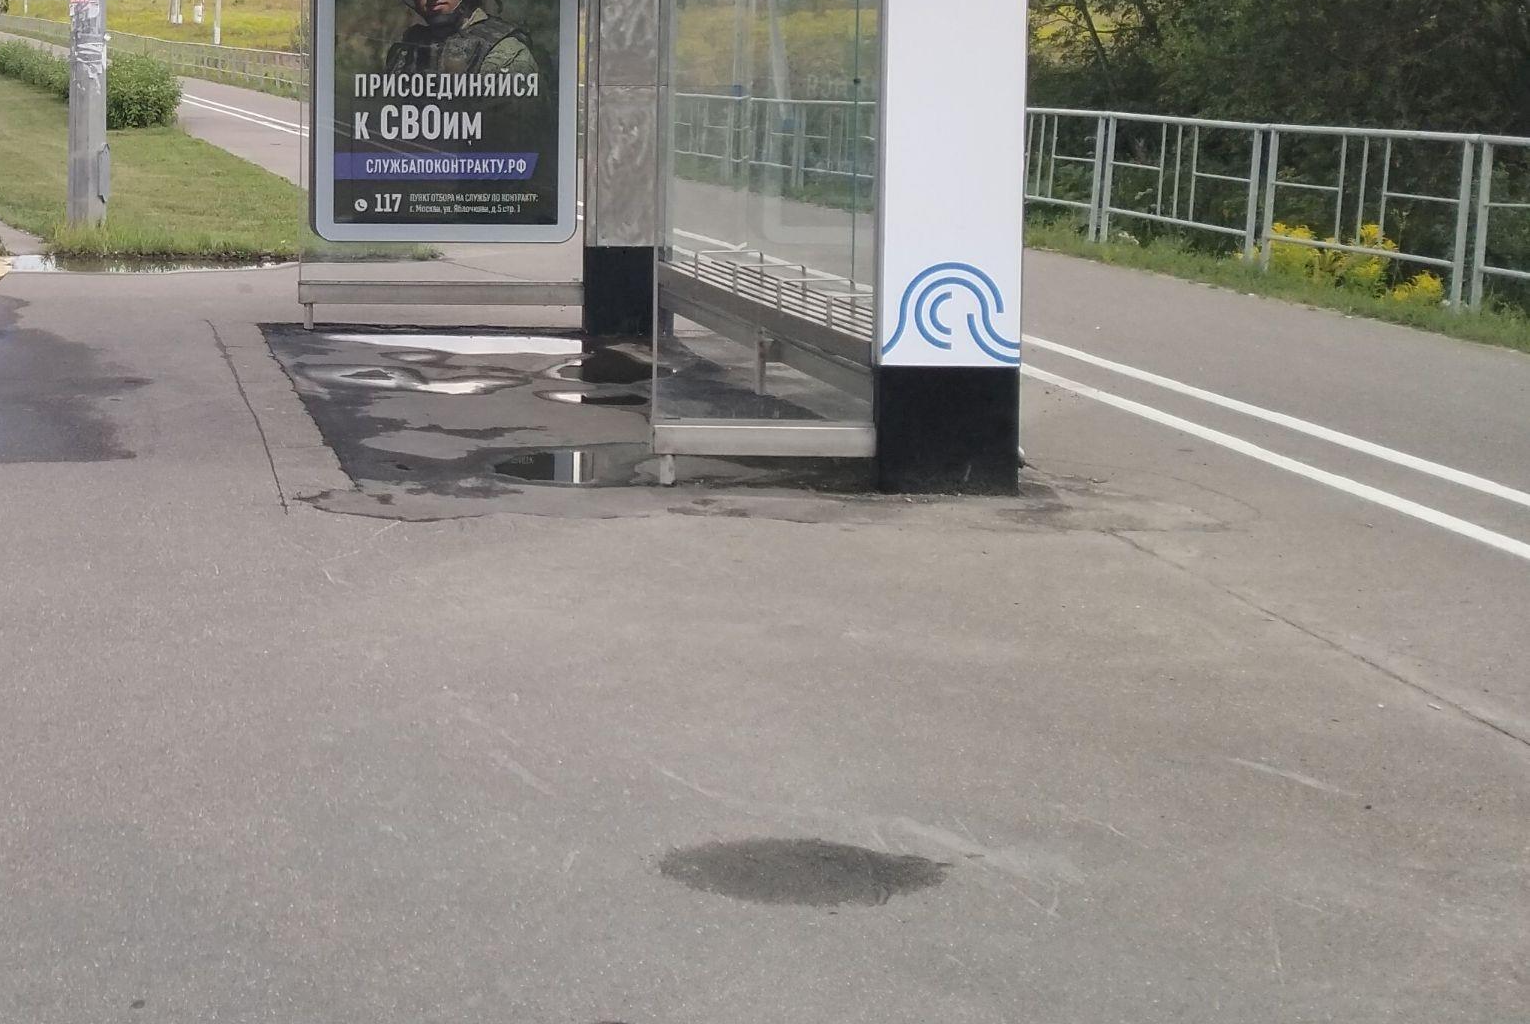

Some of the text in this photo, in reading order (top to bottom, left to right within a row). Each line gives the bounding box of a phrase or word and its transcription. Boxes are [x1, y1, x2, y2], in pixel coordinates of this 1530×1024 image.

[354, 68, 539, 101] ПРИСОЕДИНЯЙСЯ
[365, 158, 528, 175] СЛУЖБАПОКОНТРАКТУ.РФ
[374, 193, 402, 213] 117
